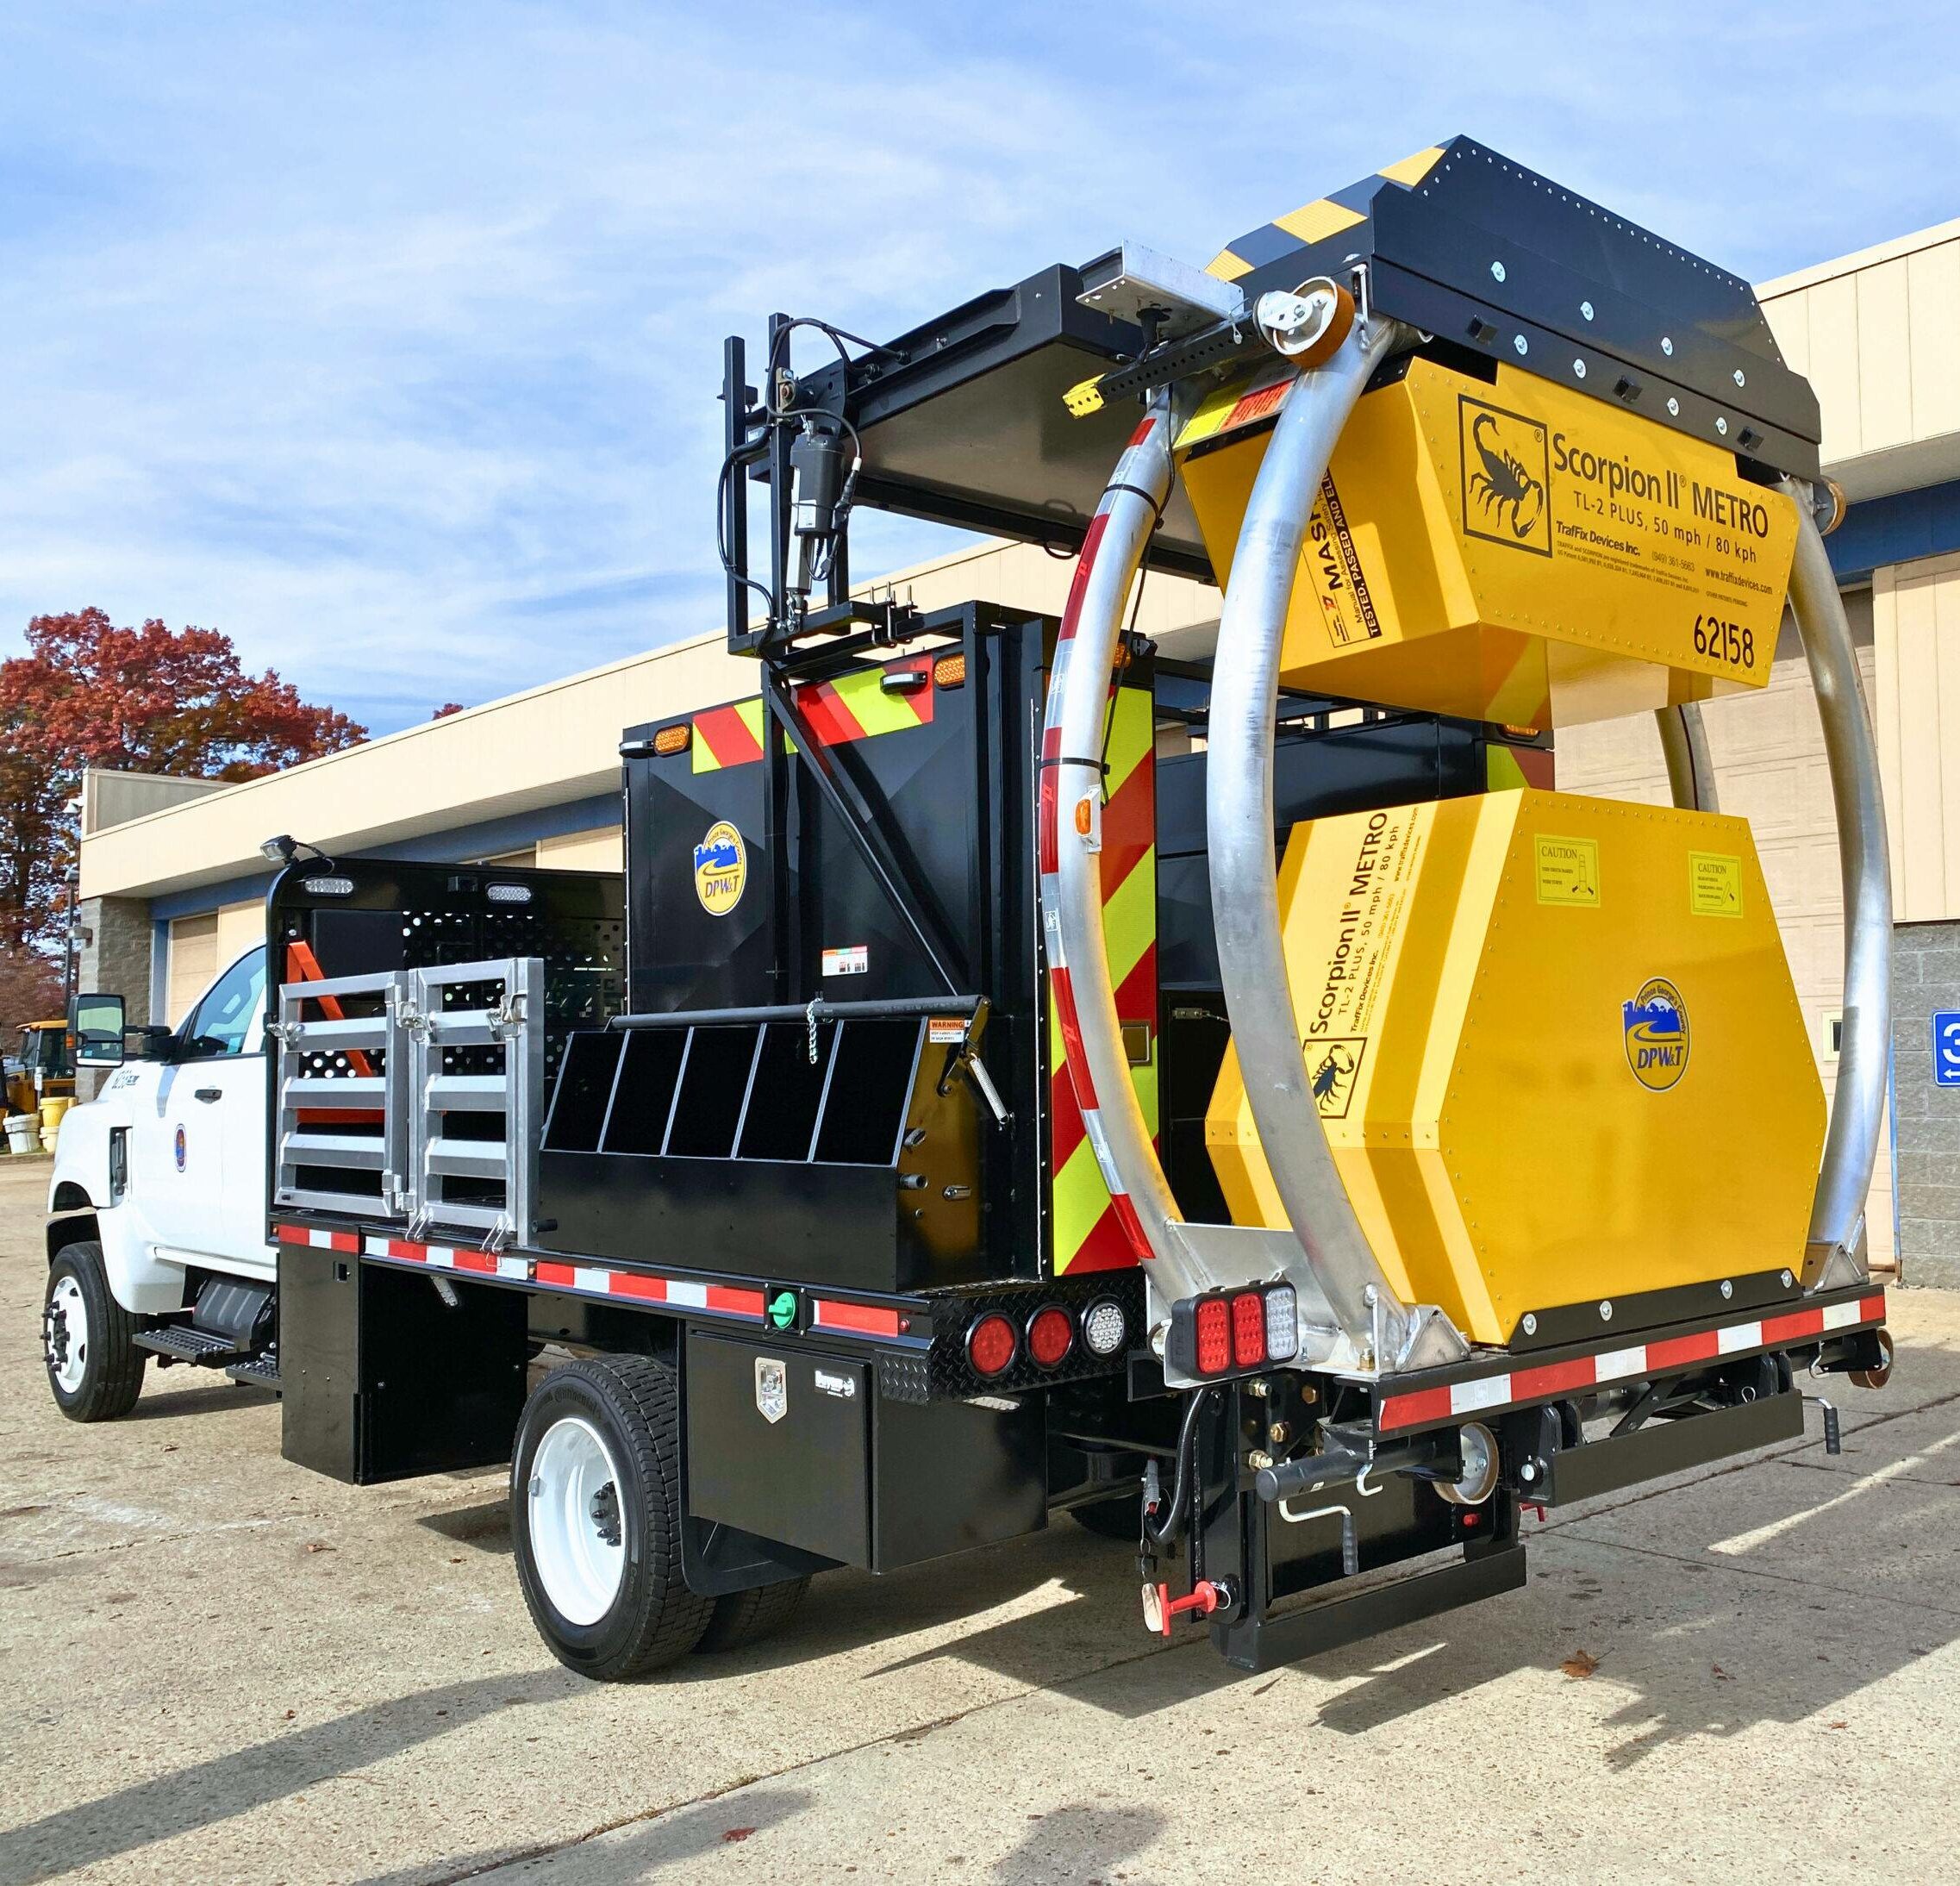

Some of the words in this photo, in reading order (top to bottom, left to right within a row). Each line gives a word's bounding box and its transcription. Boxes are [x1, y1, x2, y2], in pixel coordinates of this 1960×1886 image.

[1552, 433, 1662, 503] Scorpion
[1692, 481, 1769, 539] METRO
[1321, 503, 1333, 531] Safety
[1330, 501, 1345, 527] AND
[1573, 490, 1605, 515] TL-2
[1610, 505, 1649, 532] PLUS,
[1654, 516, 1670, 537] 50
[1674, 525, 1701, 547] mph
[1706, 531, 1711, 549] /
[1716, 534, 1731, 556] 80
[1734, 540, 1757, 564] kph
[1330, 531, 1349, 576] Assessing
[1556, 520, 1589, 542] TrafFix
[1589, 530, 1625, 552] Devices
[1626, 541, 1641, 557] Inc.
[1339, 531, 1361, 581] PASSED
[1705, 567, 1773, 595] www.traffixdevices.com
[1347, 591, 1363, 623] Manual
[1358, 583, 1378, 635] TESTED,
[1693, 613, 1755, 670] 62158
[1385, 826, 1400, 850] kph
[1395, 807, 1420, 882] www.traffixdevices.com
[1541, 846, 1577, 859] CAUTION
[1380, 855, 1391, 871] 80
[1698, 863, 1726, 874] CAUTION
[705, 875, 740, 898] DPW&T
[1369, 887, 1383, 915] mph
[1309, 927, 1356, 1034] Scorpion
[1349, 812, 1388, 896] METRO
[1361, 921, 1372, 936] 50
[1348, 942, 1368, 980] PLUS,
[1338, 985, 1354, 1015] TL-2
[1351, 1001, 1364, 1033] TrafFix
[1359, 965, 1374, 1002] Devices
[1370, 949, 1379, 965] Inc.
[1638, 1046, 1683, 1070] DPW&T
